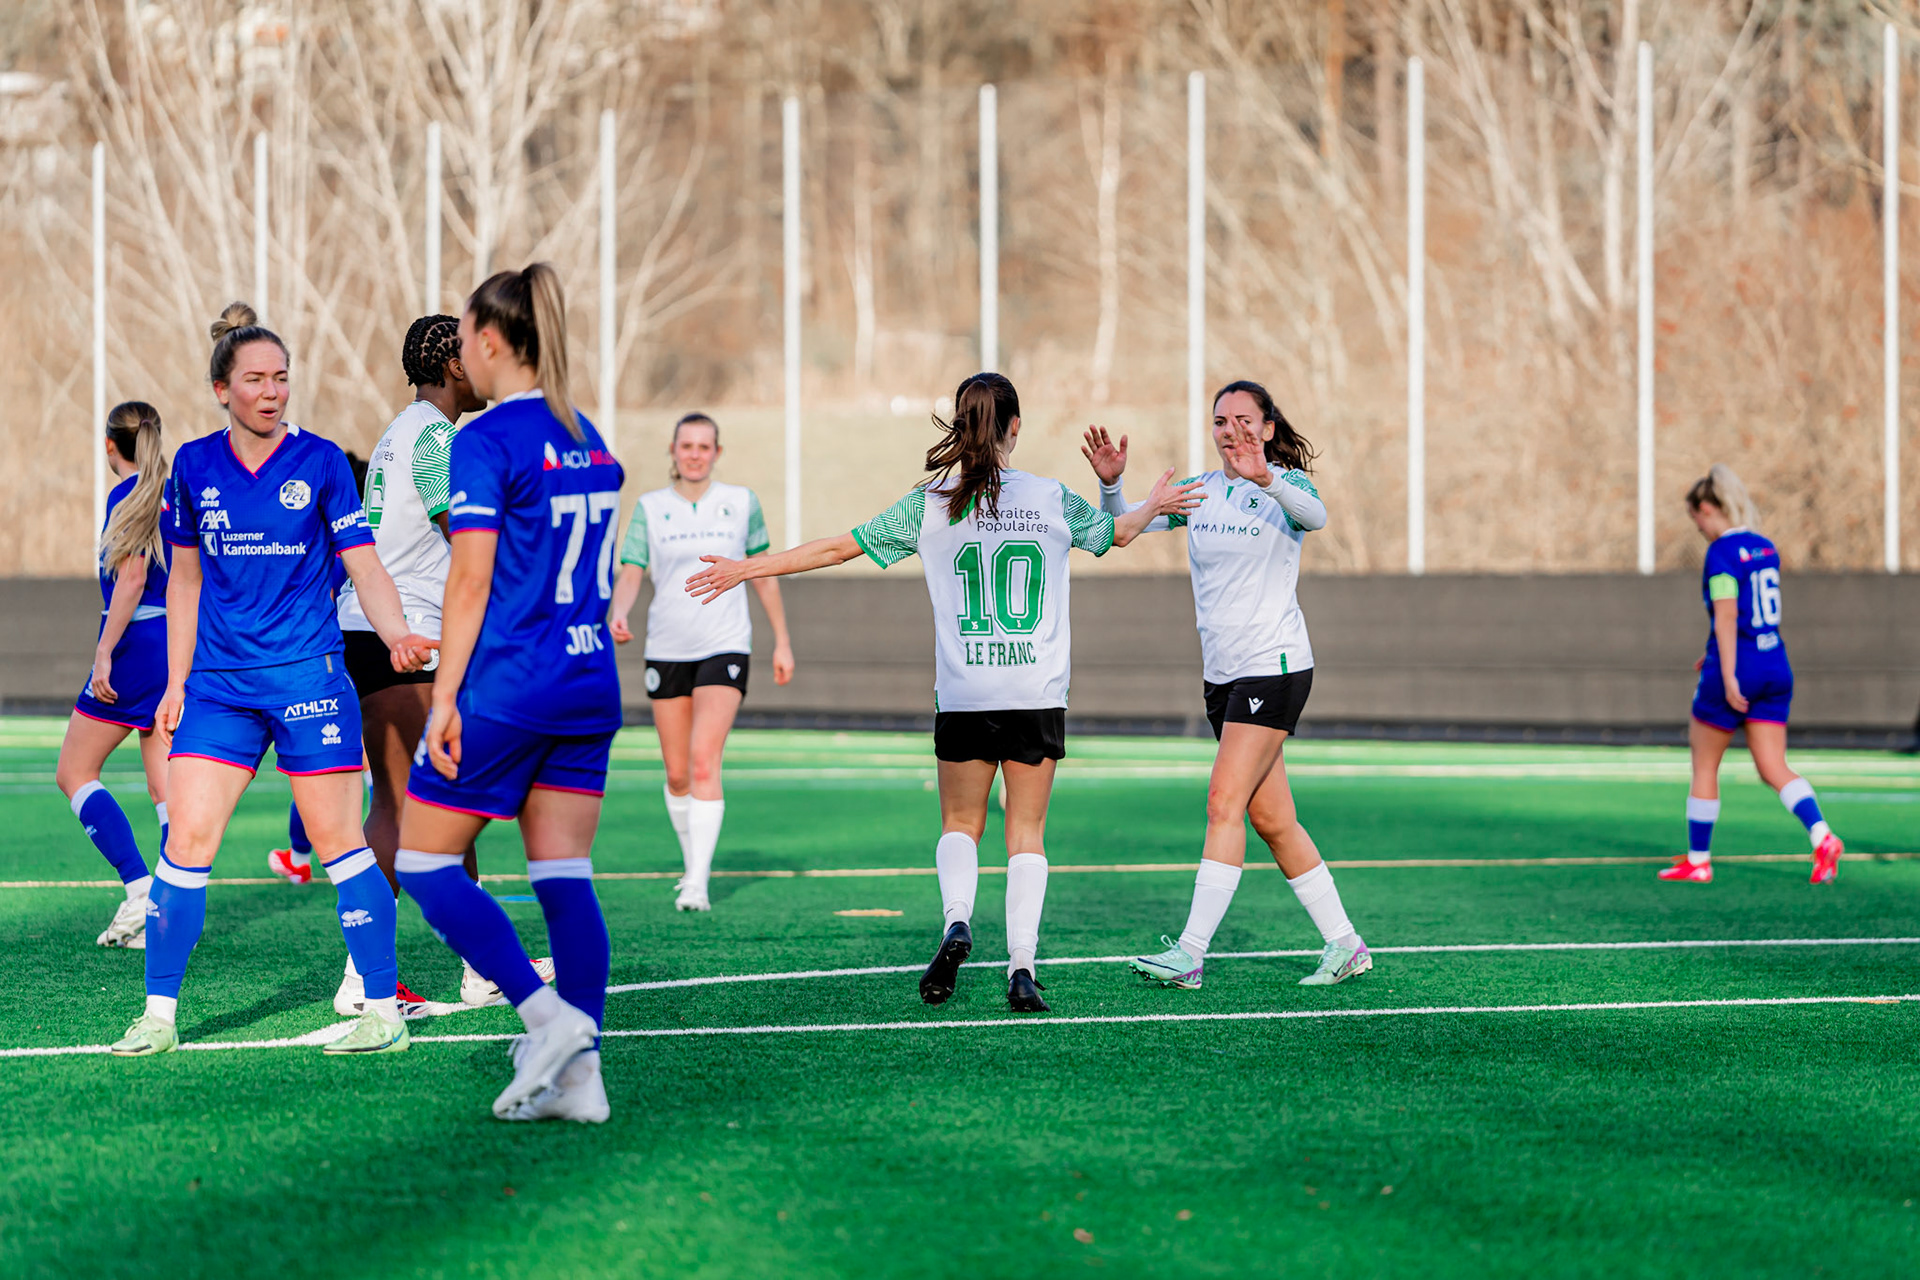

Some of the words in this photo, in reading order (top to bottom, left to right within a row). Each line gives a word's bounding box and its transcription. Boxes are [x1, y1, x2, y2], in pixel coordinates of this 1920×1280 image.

[200, 509, 231, 530] AXA
[977, 520, 1049, 534] Populaires
[221, 531, 265, 542] Luzerner
[550, 491, 620, 604] 77
[222, 541, 307, 556] Kantonalbank
[953, 540, 1046, 636] 10
[1750, 567, 1781, 628] 16
[965, 641, 984, 666] LE
[988, 641, 1037, 667] FRANC
